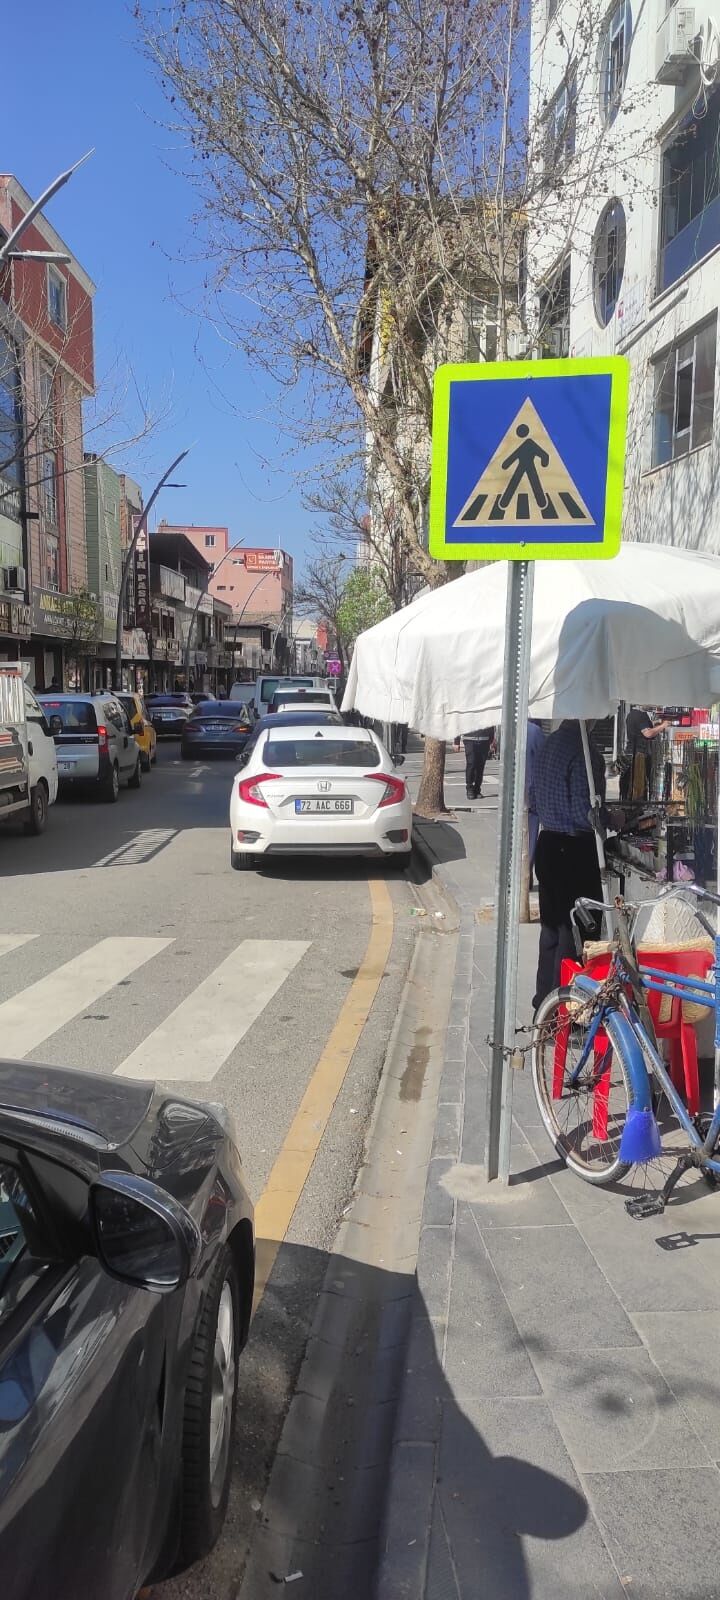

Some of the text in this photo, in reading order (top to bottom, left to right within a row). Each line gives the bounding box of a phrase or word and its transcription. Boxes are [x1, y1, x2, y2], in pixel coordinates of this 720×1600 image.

[301, 801, 350, 810] 72 AAC 666
